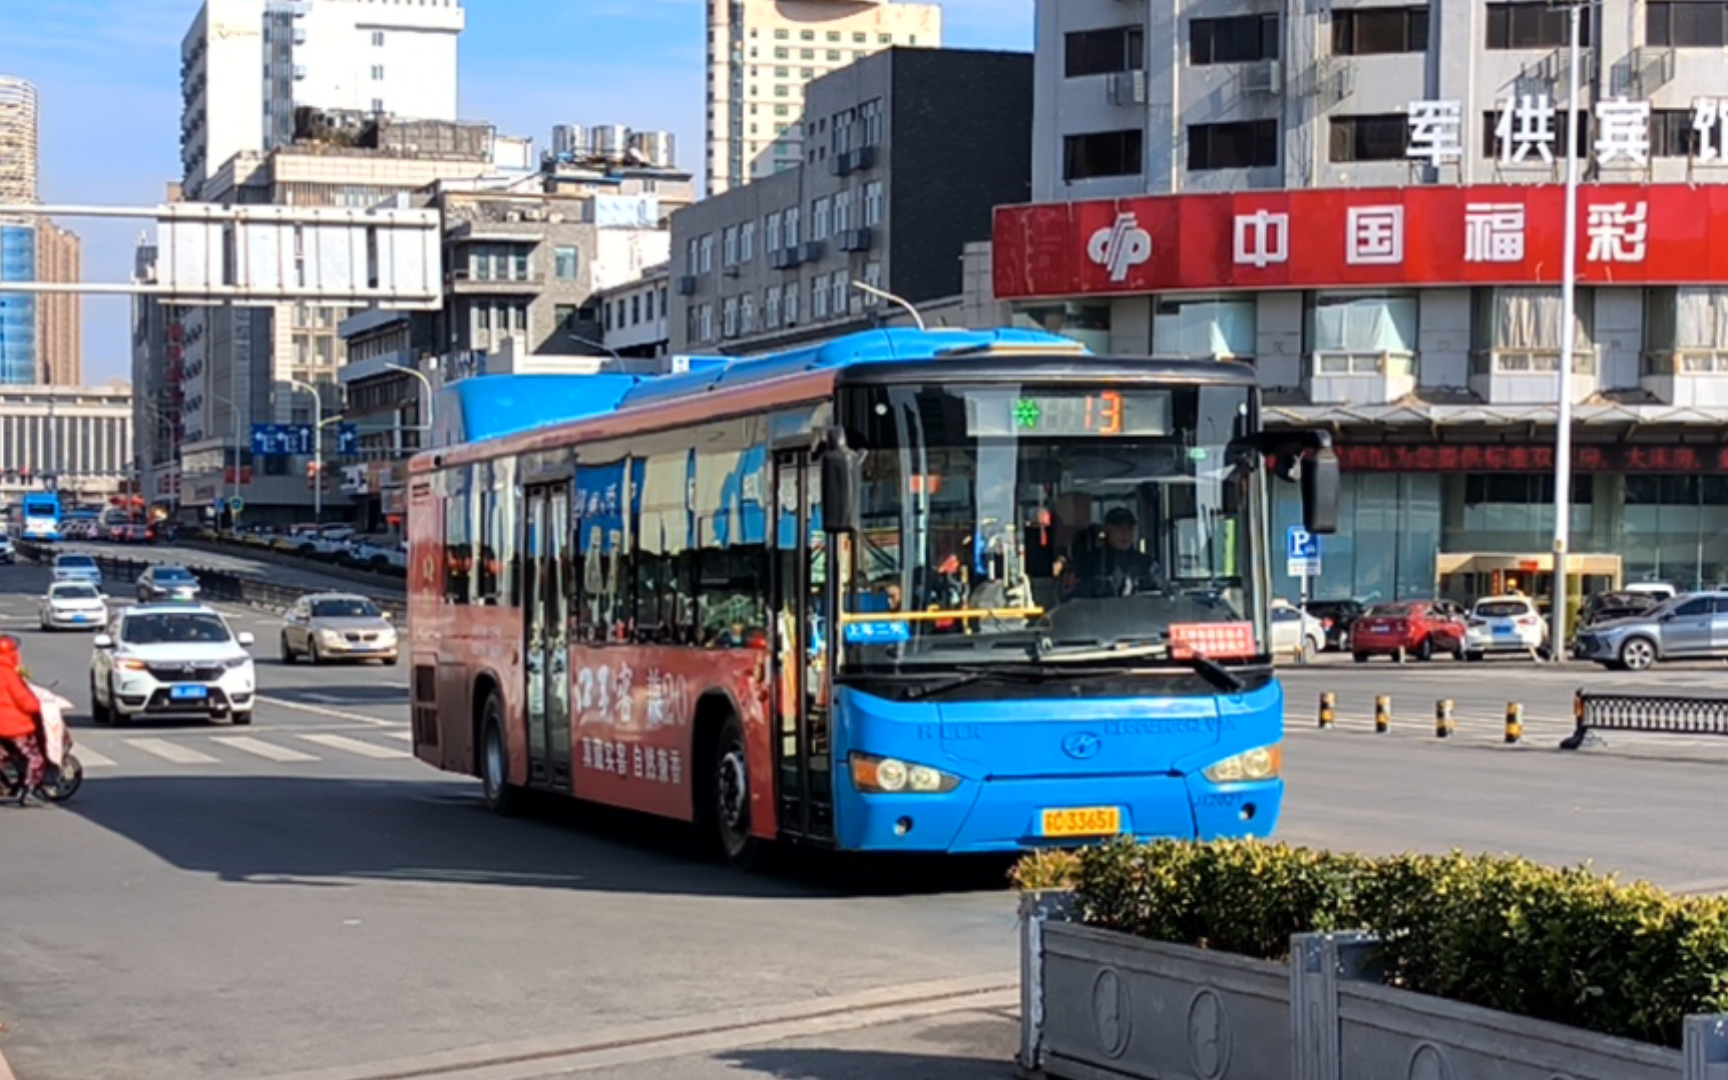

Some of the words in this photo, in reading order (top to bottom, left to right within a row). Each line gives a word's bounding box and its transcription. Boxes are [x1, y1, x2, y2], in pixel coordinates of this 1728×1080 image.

[1233, 201, 1647, 267] 中国福彩
[1085, 391, 1122, 433] 13
[1292, 531, 1310, 555] P
